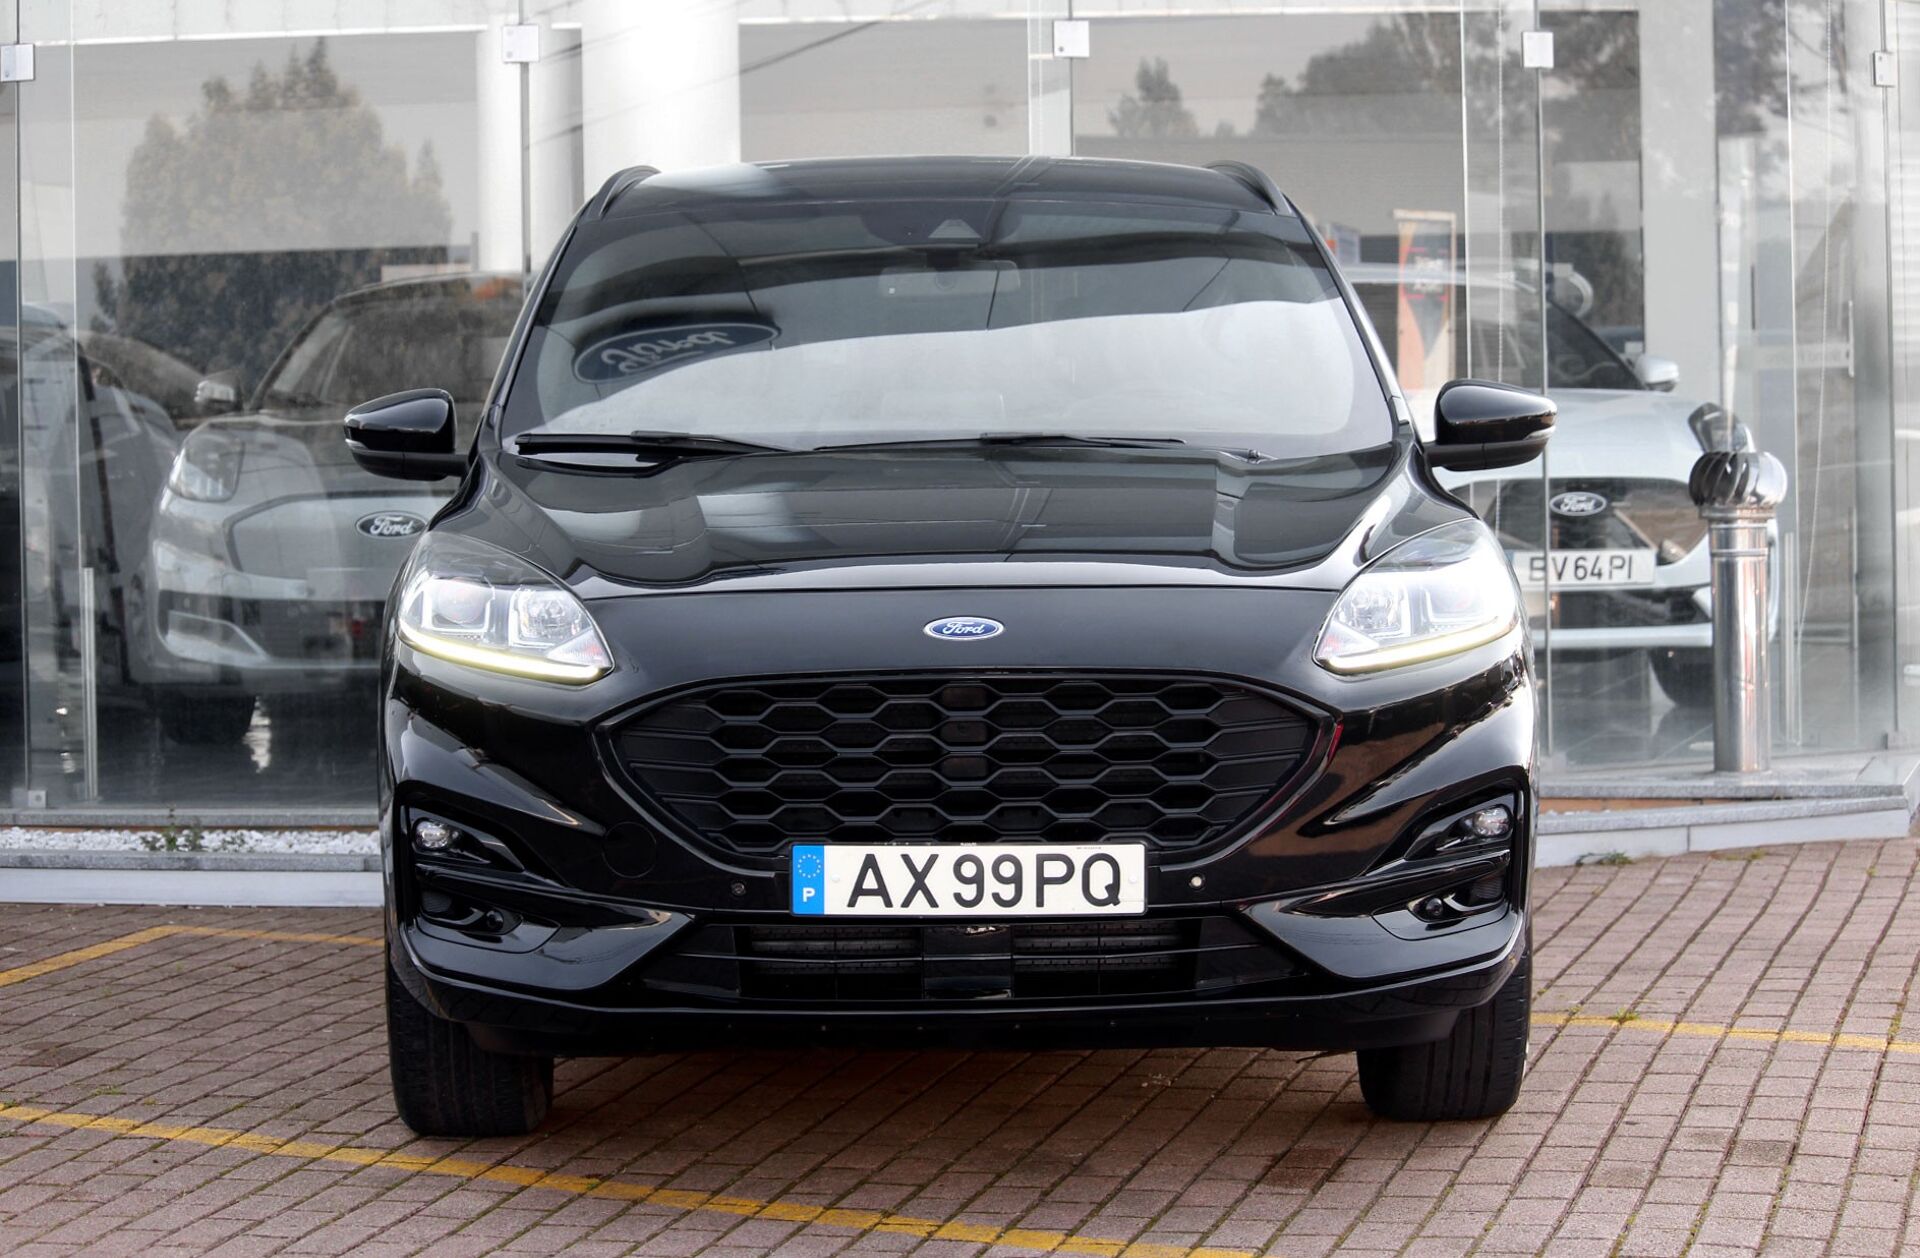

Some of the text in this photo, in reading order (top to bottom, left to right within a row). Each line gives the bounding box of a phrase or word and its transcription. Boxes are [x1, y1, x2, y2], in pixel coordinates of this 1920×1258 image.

[1560, 494, 1596, 512] Ford
[370, 516, 414, 535] Ford
[943, 621, 985, 634] Ford
[803, 888, 815, 902] P
